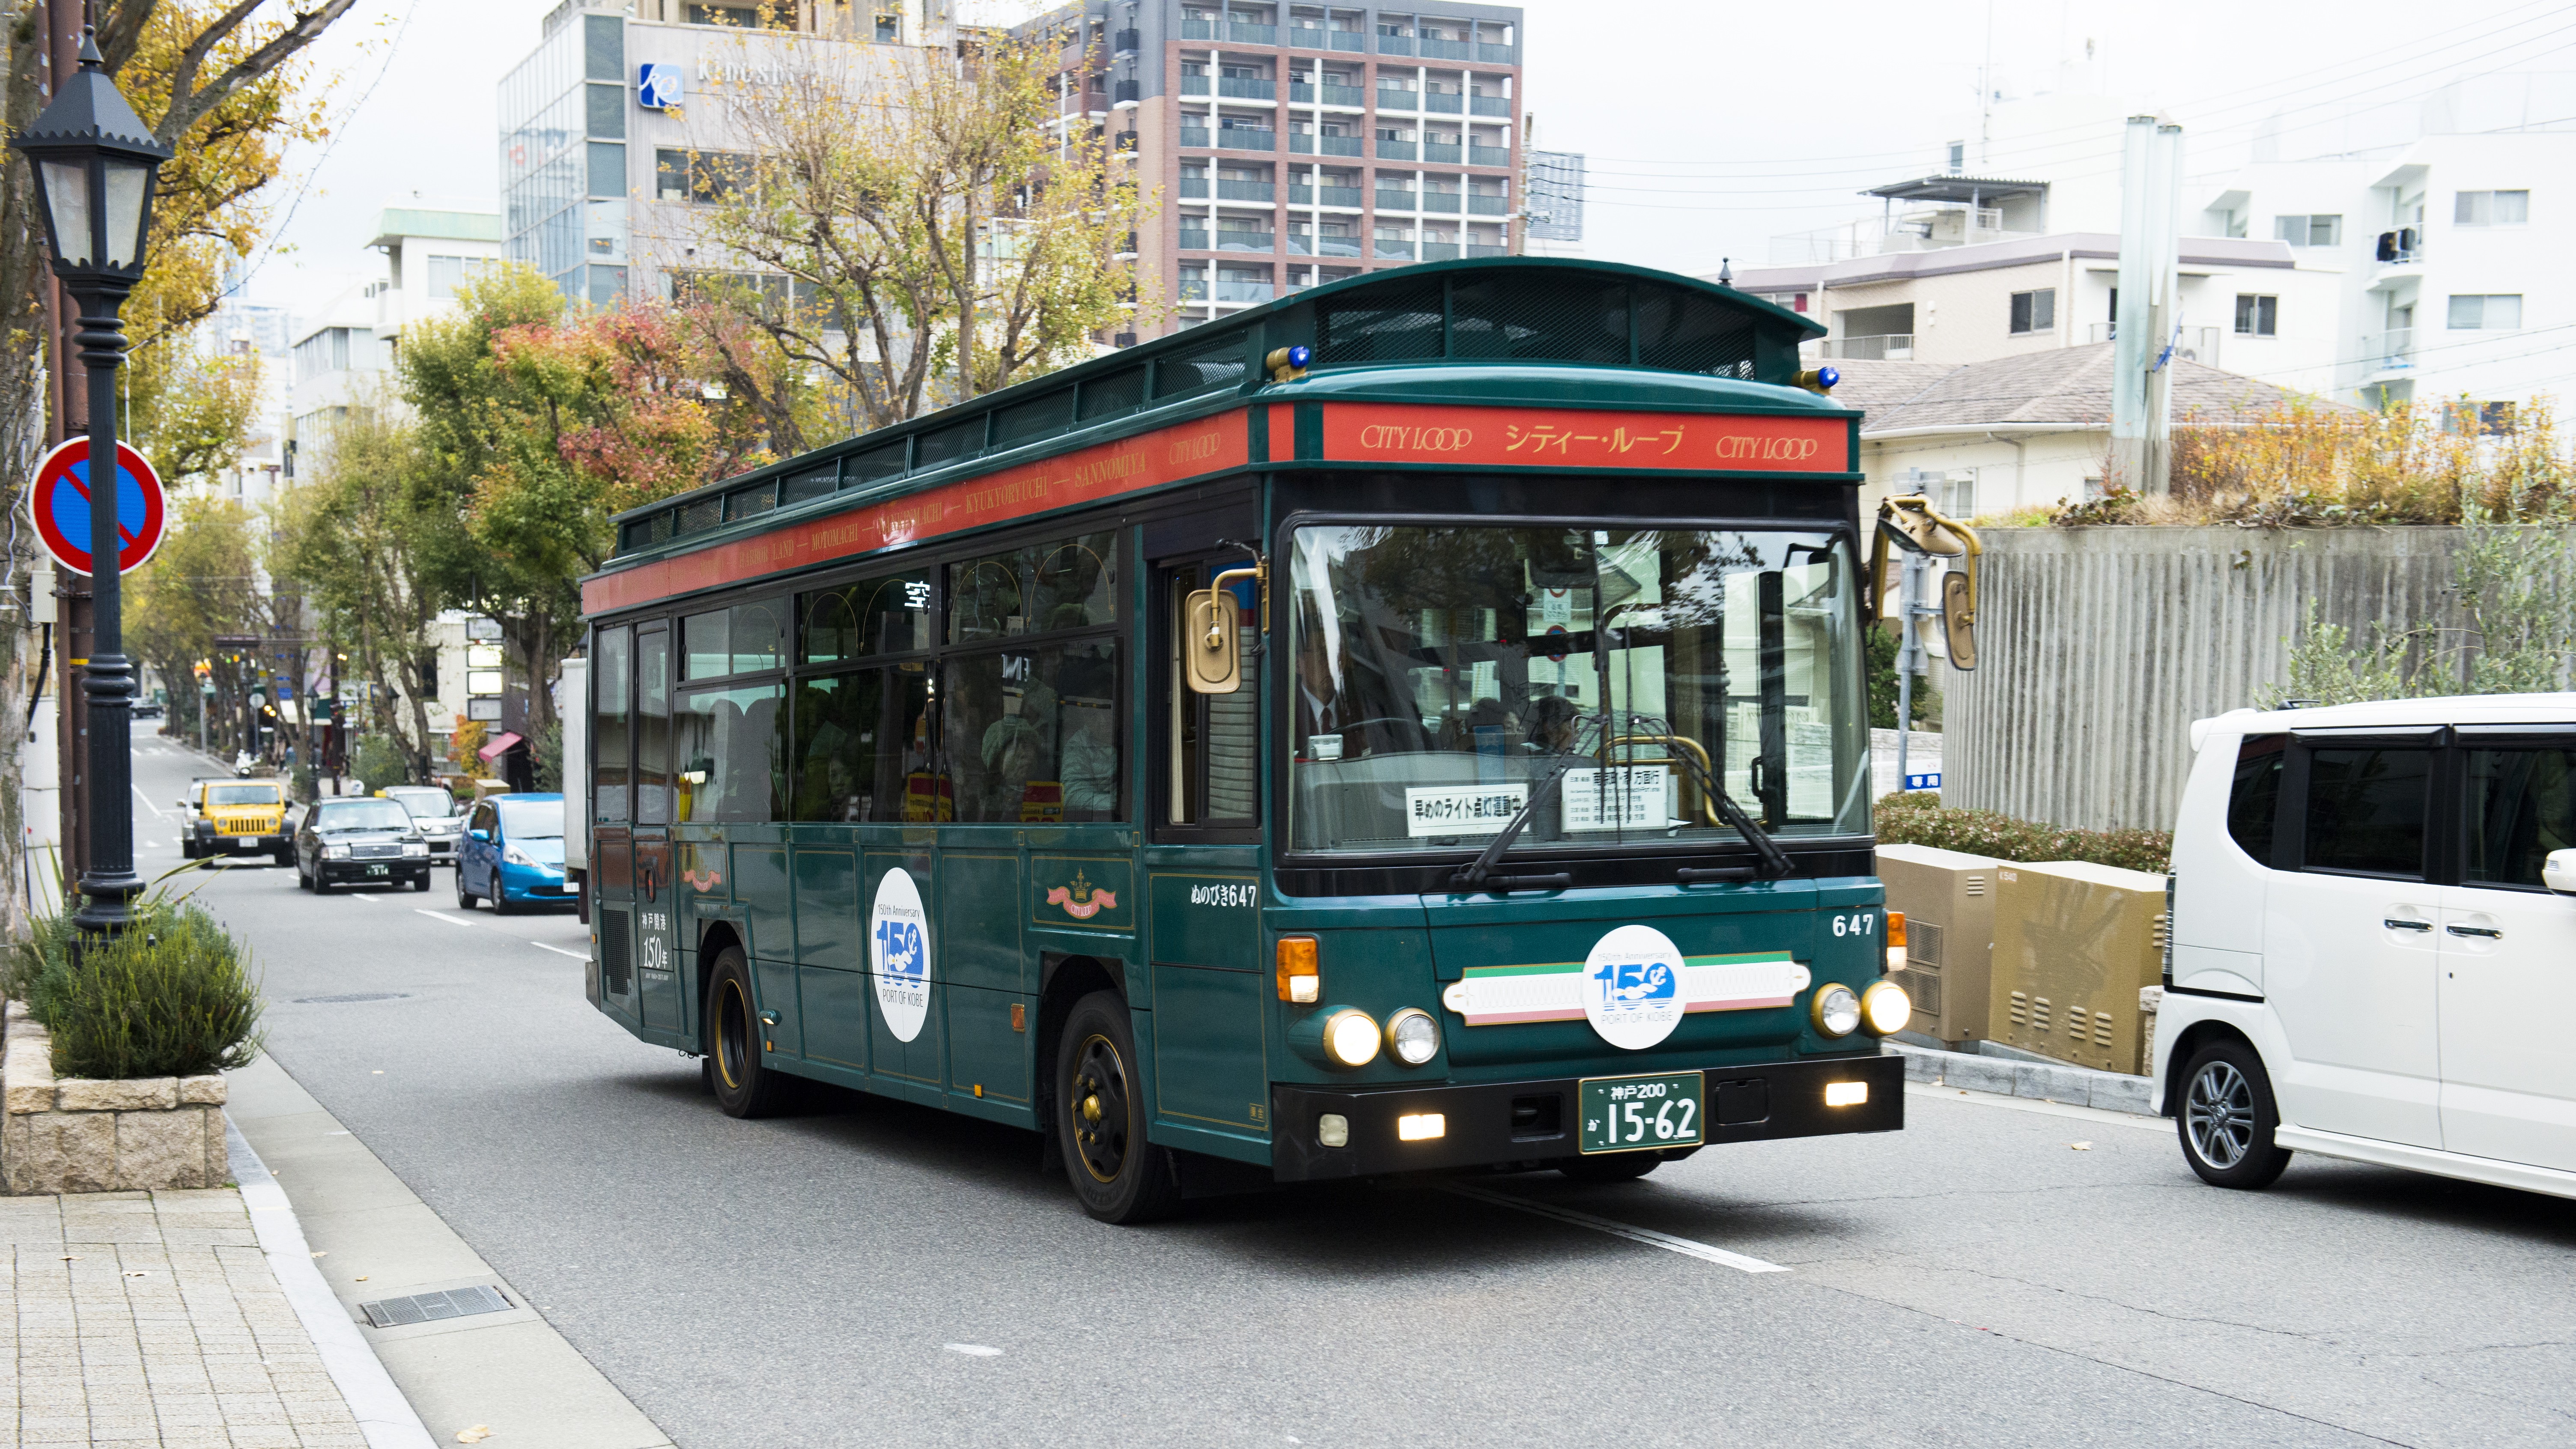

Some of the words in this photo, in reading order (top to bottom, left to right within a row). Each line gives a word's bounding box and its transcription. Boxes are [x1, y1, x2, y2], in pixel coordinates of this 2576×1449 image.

[1361, 425, 1411, 449] CITY
[1412, 427, 1473, 451] LOOP
[1506, 424, 1685, 455] シティー・ループ
[1715, 435, 1762, 458] CITY
[1762, 437, 1818, 460] LOOP
[772, 538, 795, 561] LAND
[812, 523, 859, 552] MOTOMACHI
[1074, 450, 1146, 488] SANNOMIYA
[1415, 795, 1521, 821] 早めのライト点灯運動中
[1191, 884, 1256, 907] ぬのびき647
[642, 912, 666, 931] 神戸開港
[878, 904, 892, 915] 150th
[893, 905, 920, 920] Anniversary
[1832, 914, 1874, 936] 647
[644, 934, 668, 969] 150年
[877, 920, 924, 988] 150
[883, 988, 897, 1003] PORT
[899, 990, 906, 1005] OF
[908, 992, 924, 1008] KOBE
[1594, 963, 1676, 1011] 150
[1601, 1014, 1628, 1024] PORT
[1630, 1013, 1643, 1023] OF
[1646, 1011, 1673, 1022] KOBE
[1609, 1098, 1696, 1143] 15-62
